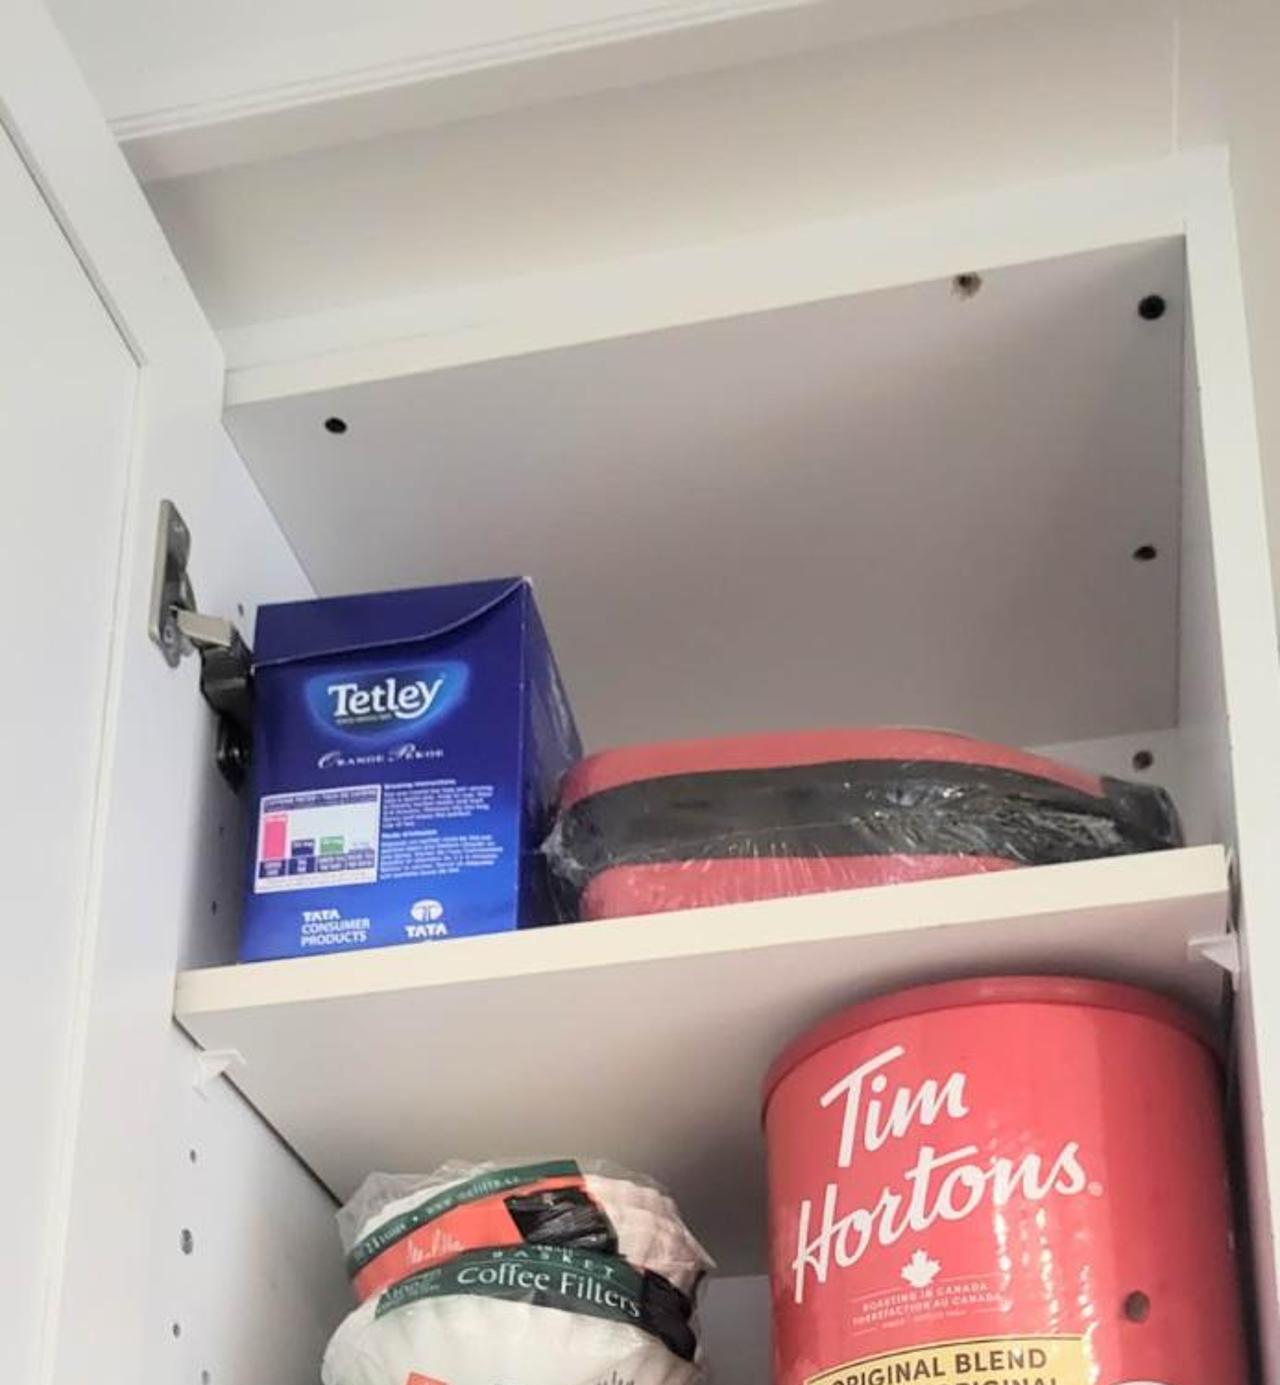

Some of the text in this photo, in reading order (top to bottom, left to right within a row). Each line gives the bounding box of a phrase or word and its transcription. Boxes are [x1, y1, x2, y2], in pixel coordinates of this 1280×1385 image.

[327, 678, 443, 719] Tetley
[302, 909, 340, 923] TATA
[302, 918, 370, 934] CONSUMER
[302, 931, 368, 947] PRODUCTS
[405, 923, 447, 938] TATA
[820, 1045, 968, 1167] Tim
[793, 1142, 1087, 1304] Hortons
[457, 1262, 550, 1290] Coffee
[561, 1272, 640, 1318] Filters
[937, 1282, 988, 1296] CANADA
[954, 1347, 1048, 1376] BLEND
